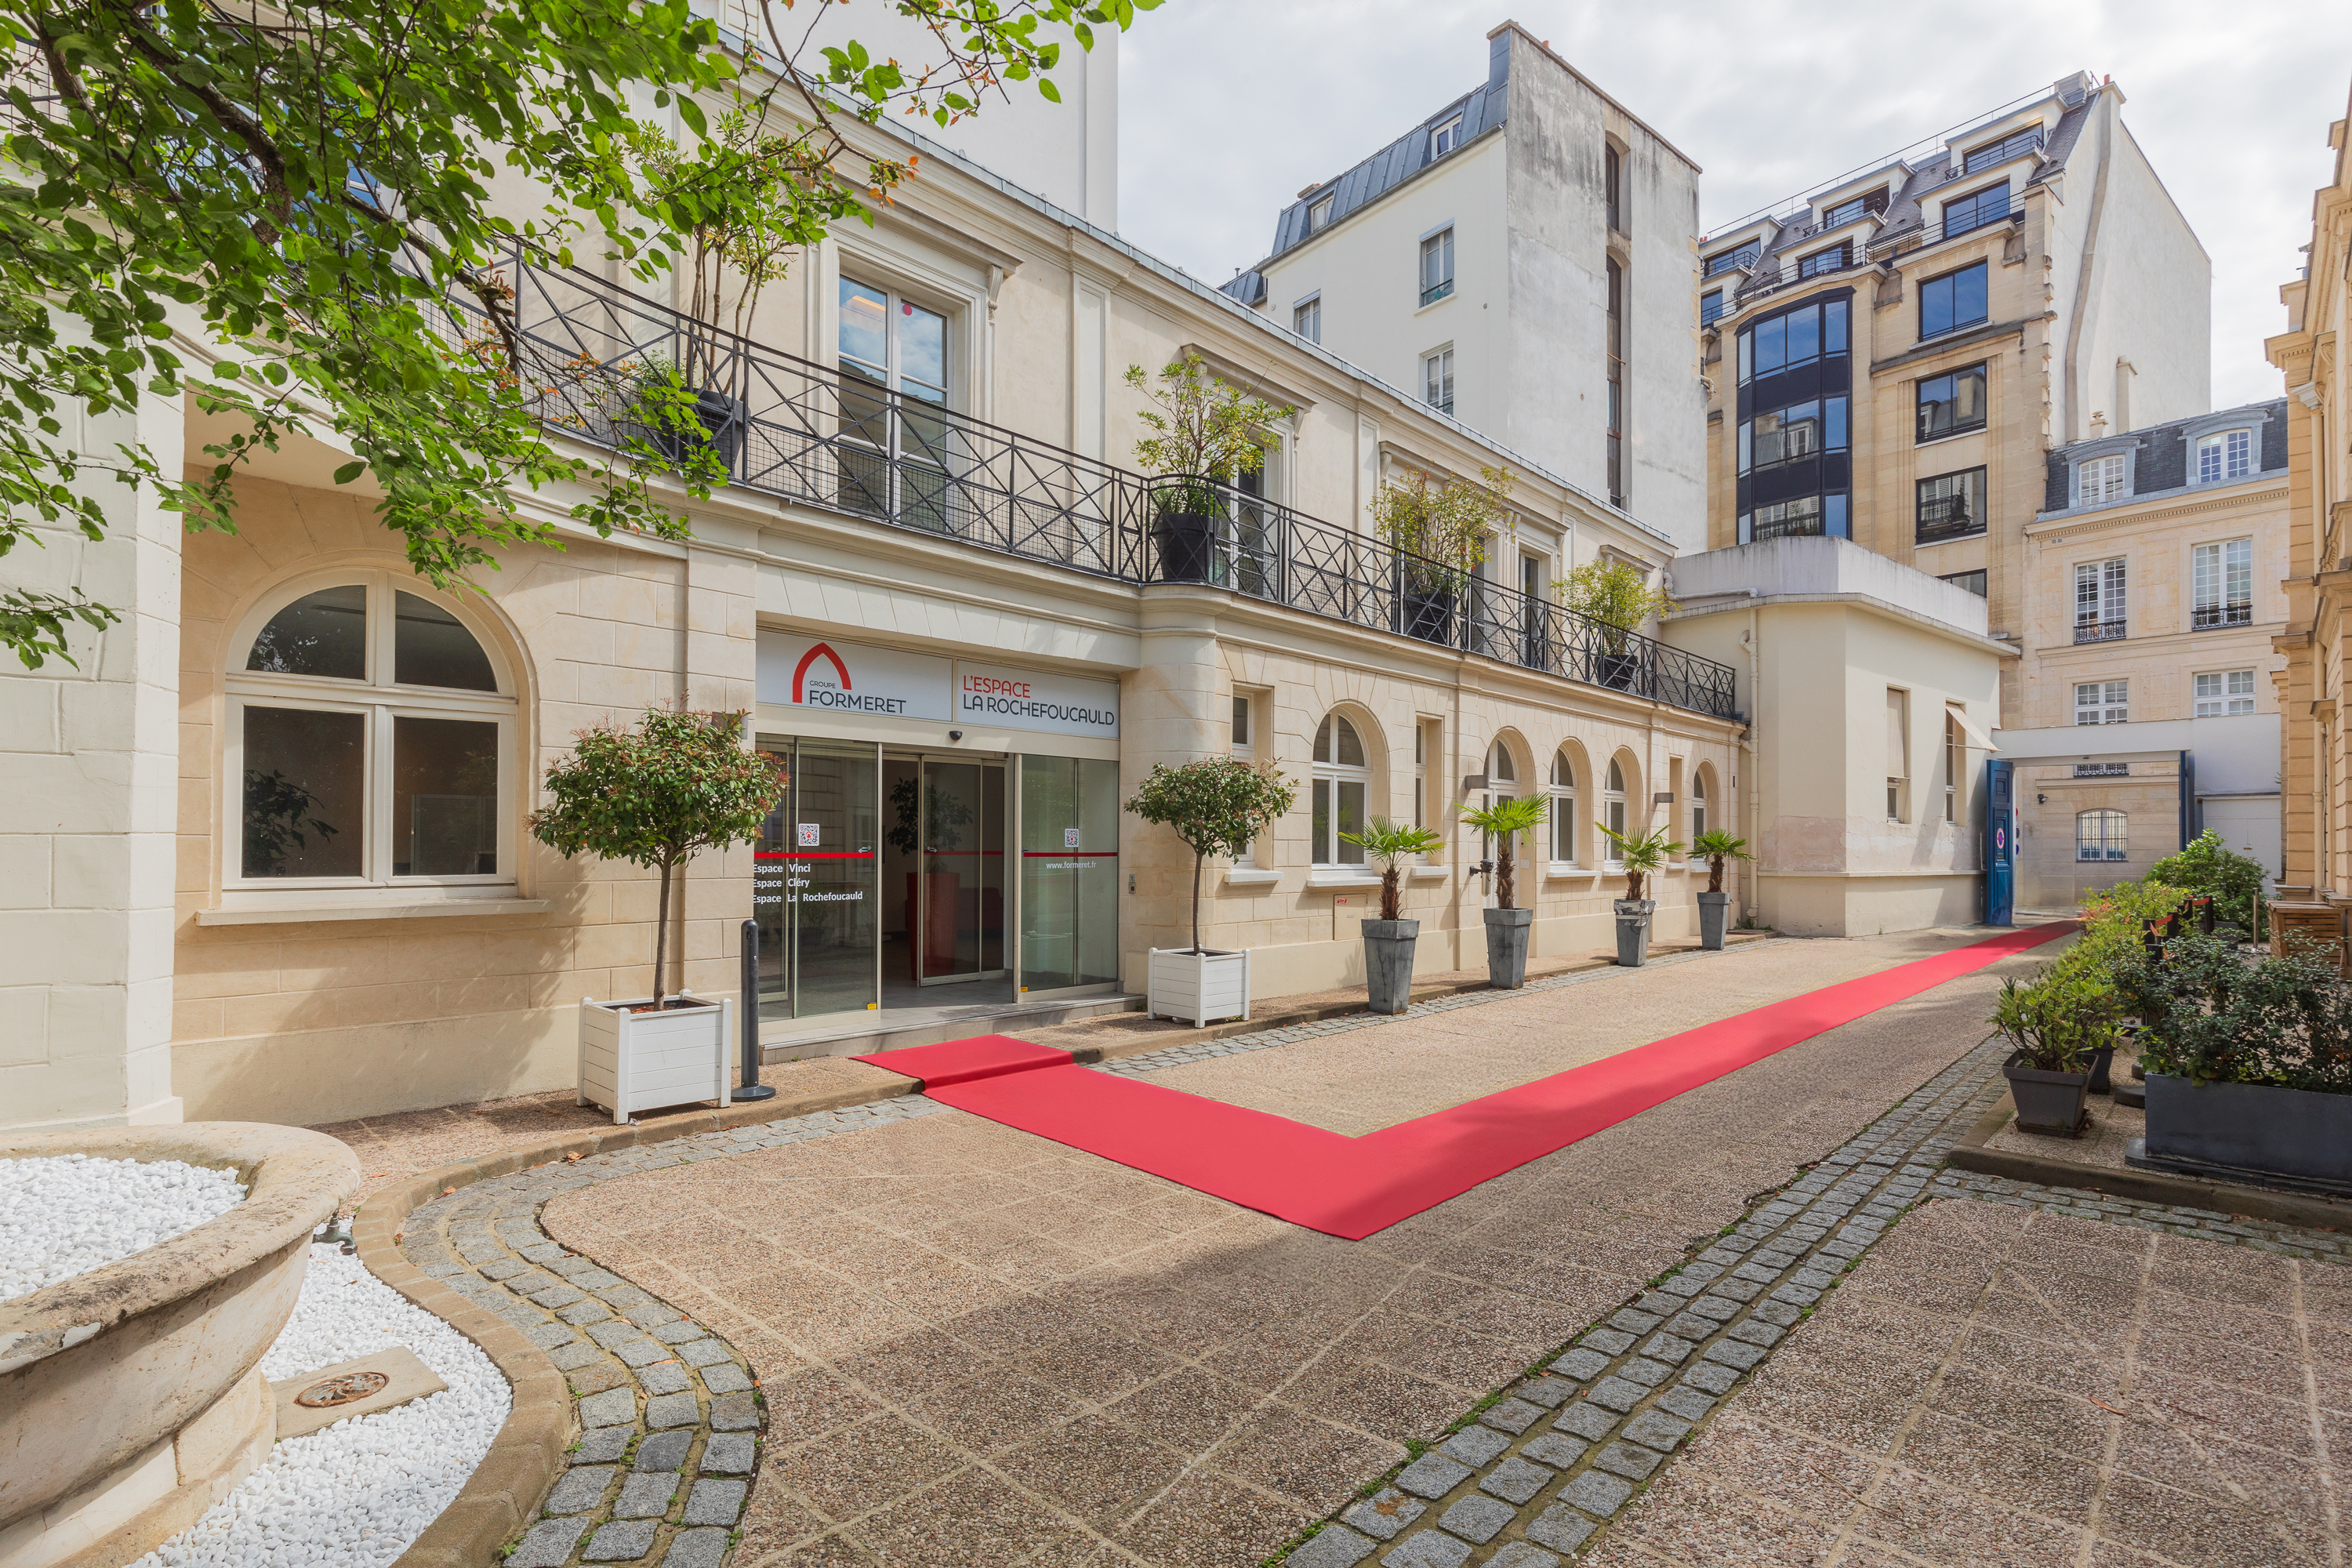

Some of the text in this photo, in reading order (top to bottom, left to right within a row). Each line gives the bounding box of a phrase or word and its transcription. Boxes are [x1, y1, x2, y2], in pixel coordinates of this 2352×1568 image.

[809, 680, 837, 688] GROUPE
[809, 690, 907, 713] FORMERET
[964, 694, 1115, 725] LA ROCHEFOUCAULD
[753, 863, 811, 874] Espace Vinci
[753, 877, 810, 889] Espace Cléry
[753, 891, 862, 904] Espace La Rochefoucauld
